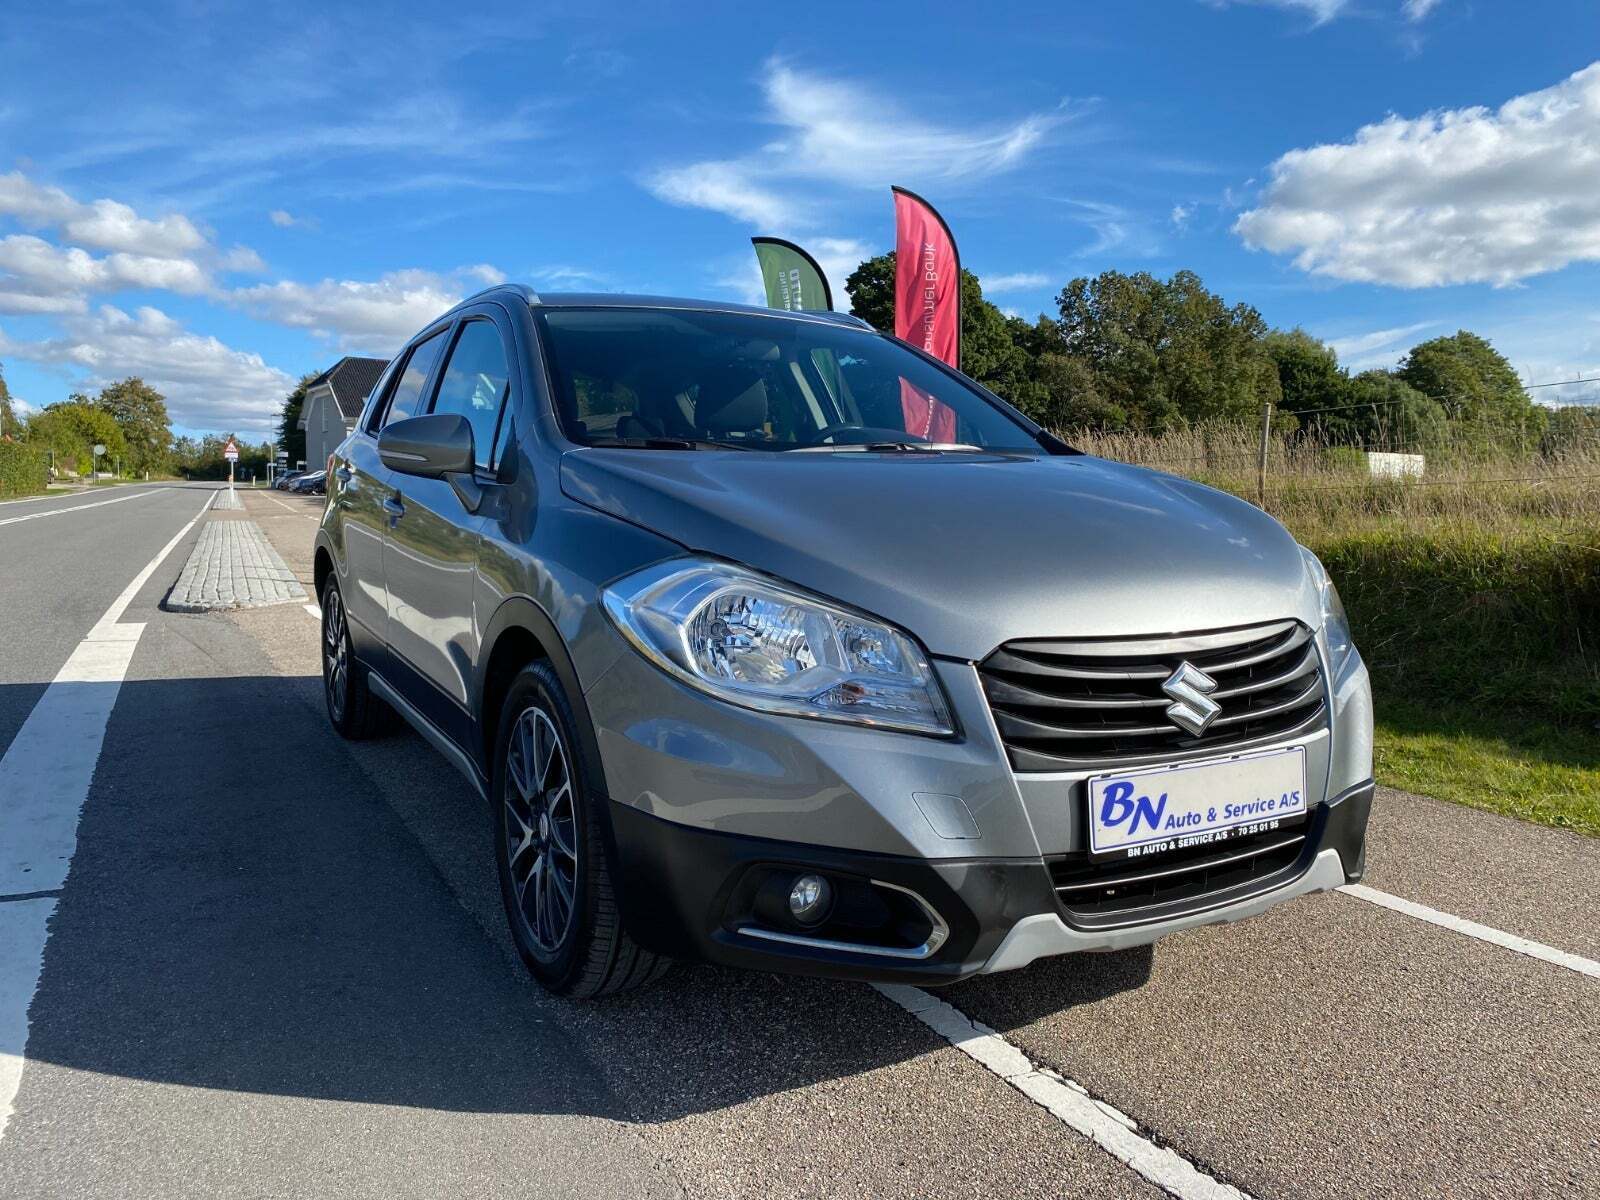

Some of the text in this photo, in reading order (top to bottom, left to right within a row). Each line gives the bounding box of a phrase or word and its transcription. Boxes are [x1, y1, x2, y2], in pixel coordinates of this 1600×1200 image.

[1100, 781, 1300, 836] BN Auto & Service A/S
[1127, 820, 1279, 858] BN AUTO & SERVICE A/S 70 25 01 95
